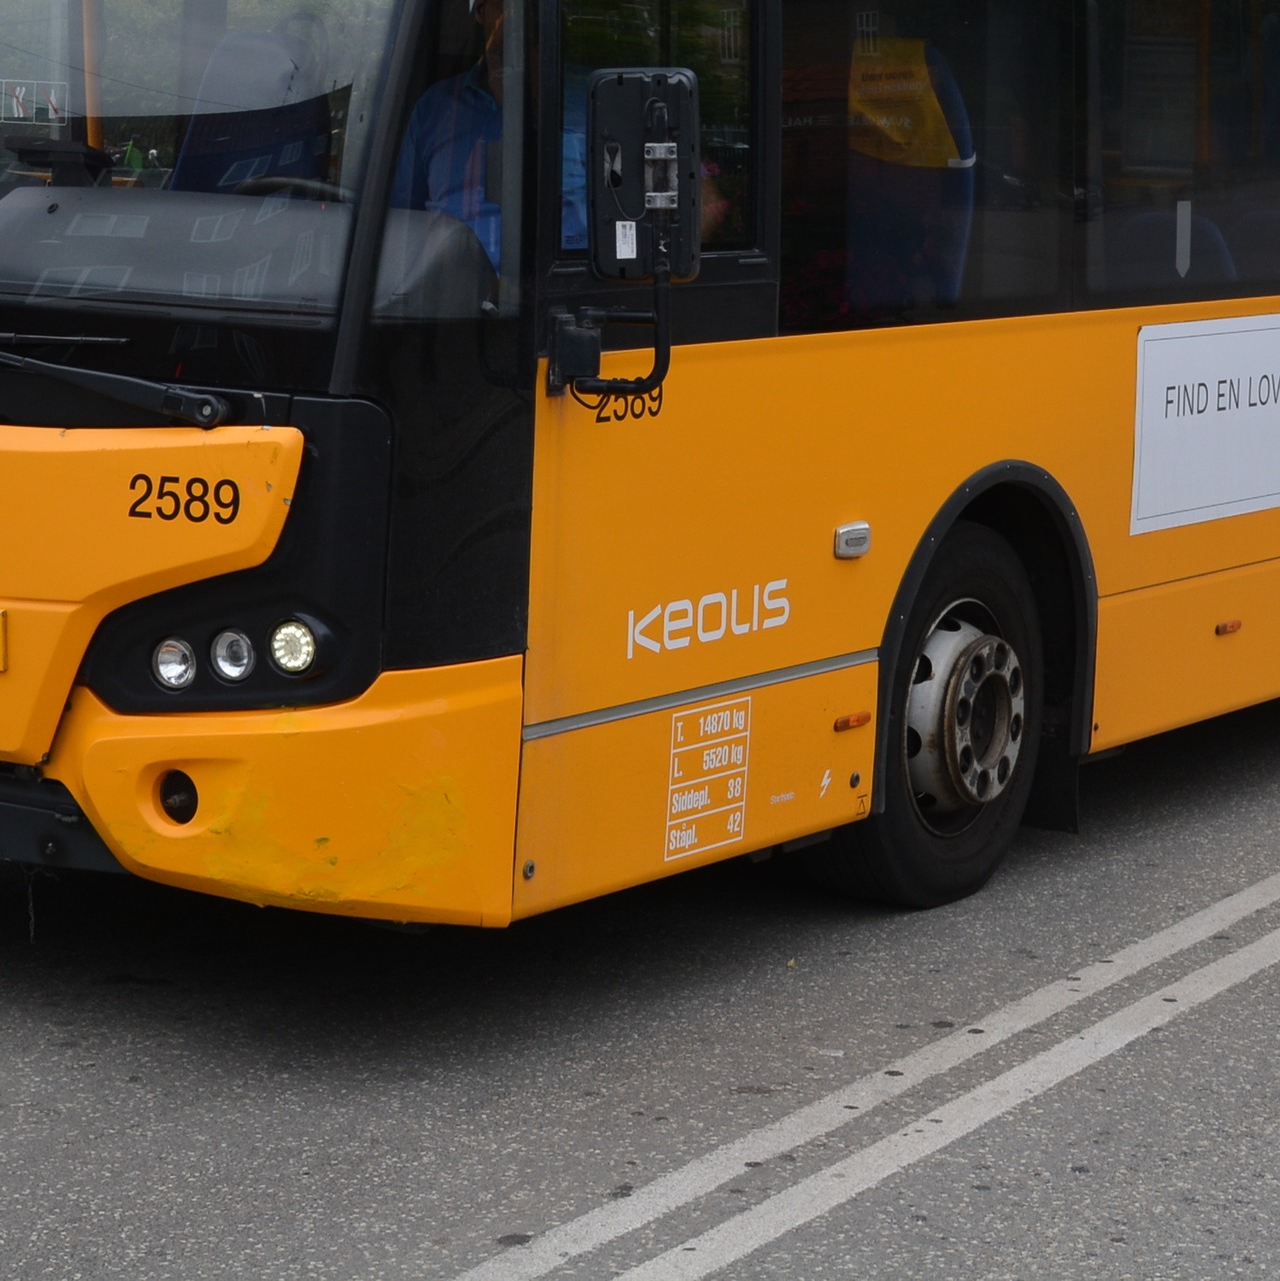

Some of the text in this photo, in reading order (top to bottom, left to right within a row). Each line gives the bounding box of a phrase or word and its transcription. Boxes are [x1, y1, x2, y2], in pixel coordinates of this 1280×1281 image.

[1165, 383, 1209, 419] FIND
[1217, 378, 1241, 411] EN
[128, 473, 240, 525] 2589
[626, 578, 790, 660] KEOLIS
[676, 708, 745, 743] T. 14870 kg
[673, 744, 743, 778] L. 5520 kg
[671, 777, 742, 814] Siddepl. 38
[669, 811, 741, 851] Ståpl. 42
